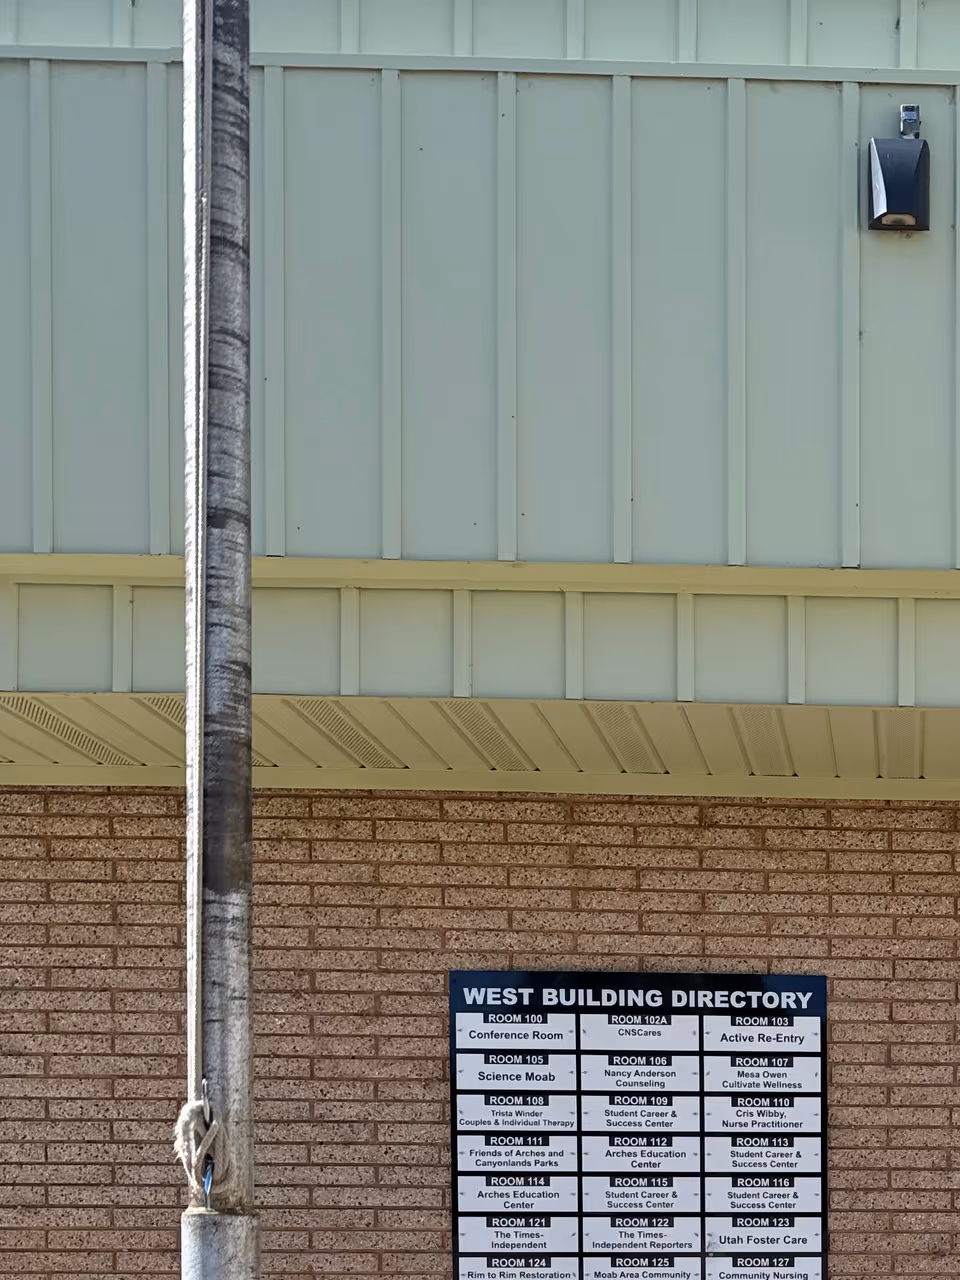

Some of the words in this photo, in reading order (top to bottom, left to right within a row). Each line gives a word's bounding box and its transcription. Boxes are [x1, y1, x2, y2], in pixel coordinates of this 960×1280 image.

[463, 988, 533, 1005] WEST
[543, 989, 662, 1006] BUILDING
[672, 990, 812, 1008] DIRECTORY
[489, 1014, 521, 1022] ROOM
[525, 1015, 544, 1024] 100
[612, 1015, 641, 1024] ROOM
[645, 1016, 667, 1024] 102A
[736, 1017, 768, 1025] ROOM
[772, 1017, 788, 1025] 103
[469, 1030, 529, 1039] Conference
[533, 1031, 563, 1039] Room
[721, 1033, 754, 1042] Active
[758, 1034, 804, 1044] Re-Entry
[488, 1055, 522, 1064] ROOM
[526, 1056, 545, 1065] 105
[612, 1056, 646, 1065] ROOM
[650, 1057, 667, 1065] 106
[736, 1058, 768, 1066] ROOM
[772, 1058, 788, 1066] 107
[478, 1072, 521, 1081] Science
[526, 1072, 555, 1081] Moab
[605, 1070, 631, 1078] Nancy
[616, 1080, 665, 1088] Counseling
[722, 1080, 760, 1088] Cultivate
[490, 1096, 522, 1104] ROOM
[527, 1097, 544, 1105] 108
[612, 1096, 647, 1105] ROOM
[651, 1097, 667, 1105] 109
[738, 1098, 769, 1106] ROOM
[774, 1098, 789, 1106] 110
[605, 1109, 637, 1117] Student
[757, 1110, 786, 1119] Wibby,
[543, 1120, 574, 1128] Therapy
[606, 1119, 642, 1127] Success
[752, 1120, 803, 1128] Practitioner
[491, 1137, 523, 1145] ROOM
[527, 1137, 542, 1145] 111
[615, 1137, 646, 1145] ROOM
[651, 1138, 667, 1146] 112
[737, 1138, 768, 1146] ROOM
[772, 1138, 788, 1146] 113
[641, 1150, 686, 1158] Education
[476, 1159, 531, 1168] Canyonlands
[631, 1160, 661, 1168] Center
[491, 1177, 524, 1185] ROOM
[528, 1177, 544, 1185] 114
[615, 1178, 647, 1186] ROOM
[652, 1178, 667, 1186] 115
[738, 1178, 769, 1186] ROOM
[493, 1218, 525, 1226] ROOM
[529, 1218, 545, 1226] 121
[616, 1218, 648, 1226] ROOM
[737, 1218, 769, 1226] ROOM
[773, 1218, 789, 1226] 123
[720, 1236, 743, 1244] Utah
[747, 1236, 780, 1244] Foster
[784, 1236, 807, 1244] Care
[492, 1242, 546, 1250] Independent
[593, 1242, 647, 1250] Independent
[650, 1241, 692, 1249] Reporters
[492, 1259, 524, 1267] ROOM
[529, 1259, 546, 1267] 124
[616, 1258, 648, 1266] ROOM
[652, 1258, 669, 1266] 125
[738, 1258, 769, 1266] ROOM
[773, 1258, 789, 1266] 127
[642, 1271, 691, 1280] Community
[719, 1272, 770, 1280] Community
[774, 1272, 808, 1280] Nursing
